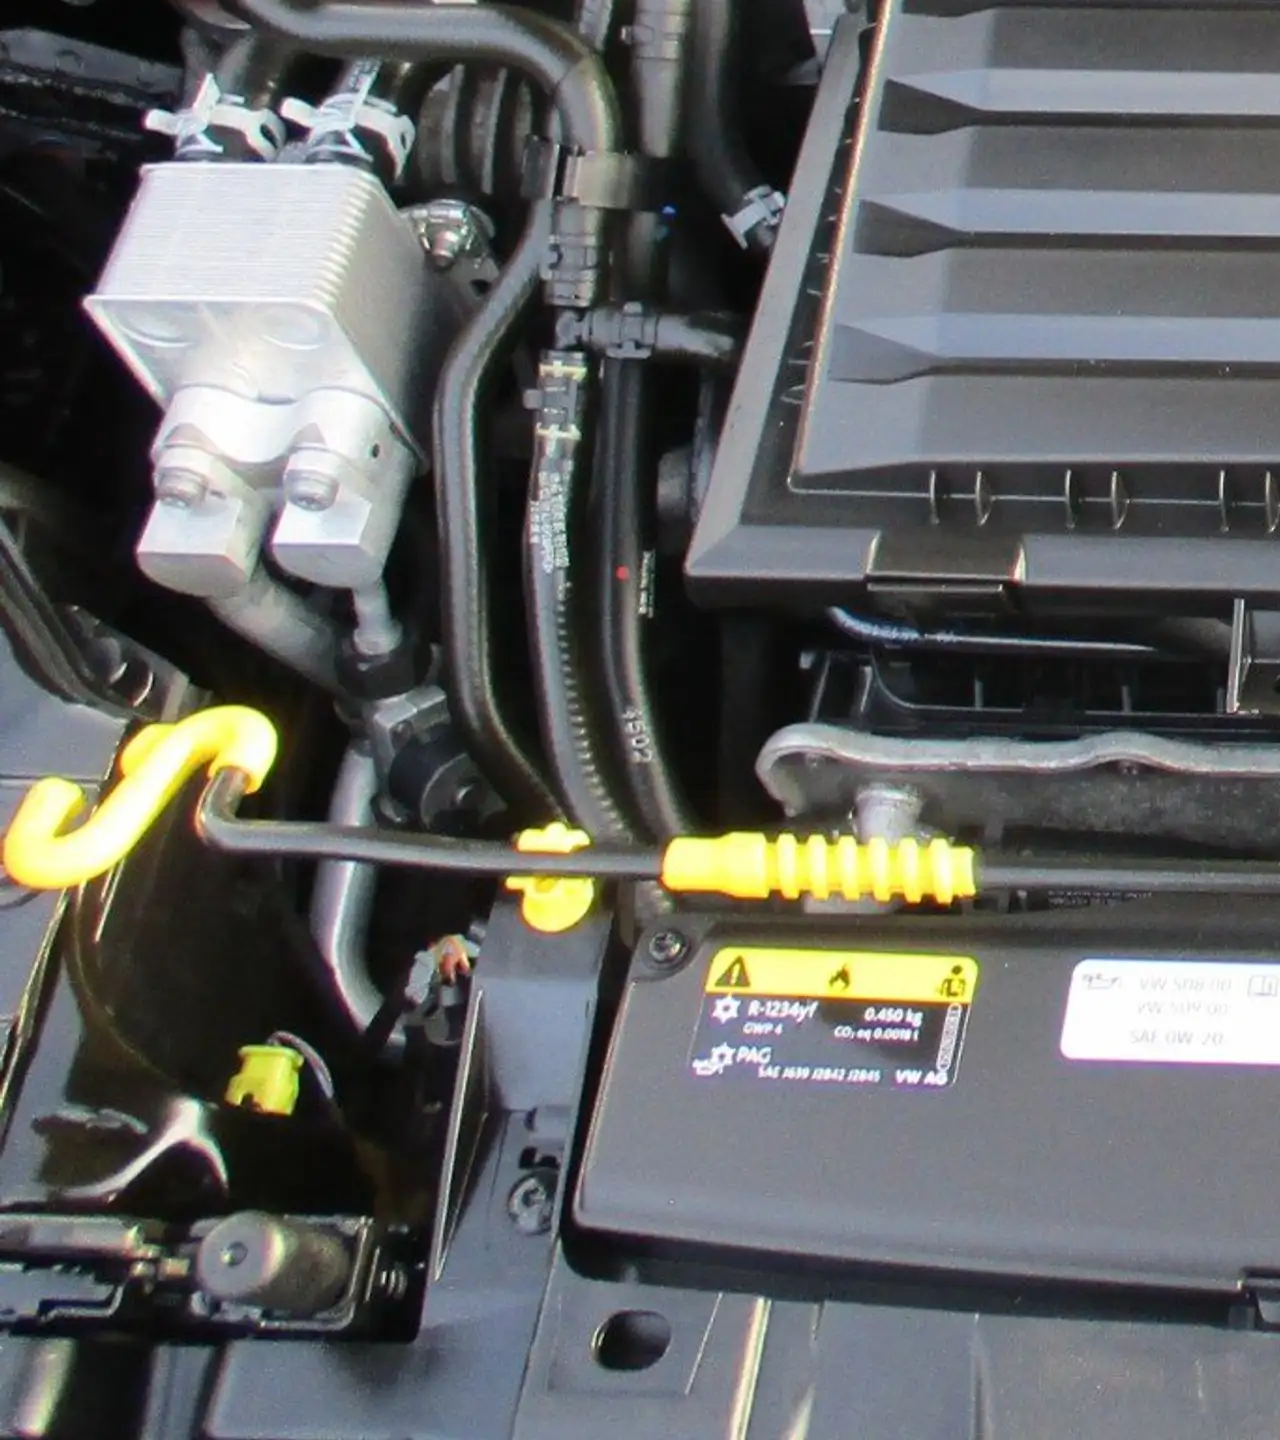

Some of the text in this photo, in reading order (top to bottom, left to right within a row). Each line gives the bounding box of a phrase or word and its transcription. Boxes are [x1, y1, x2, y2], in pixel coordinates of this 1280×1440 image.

[1139, 977, 1167, 991] VW
[748, 999, 819, 1022] R-1234yf
[905, 1009, 924, 1028] kg
[742, 1022, 772, 1035] GWP
[736, 1046, 772, 1064] PAG
[757, 1065, 781, 1079] SAE
[895, 1069, 922, 1085] VW
[923, 1071, 948, 1086] AG
